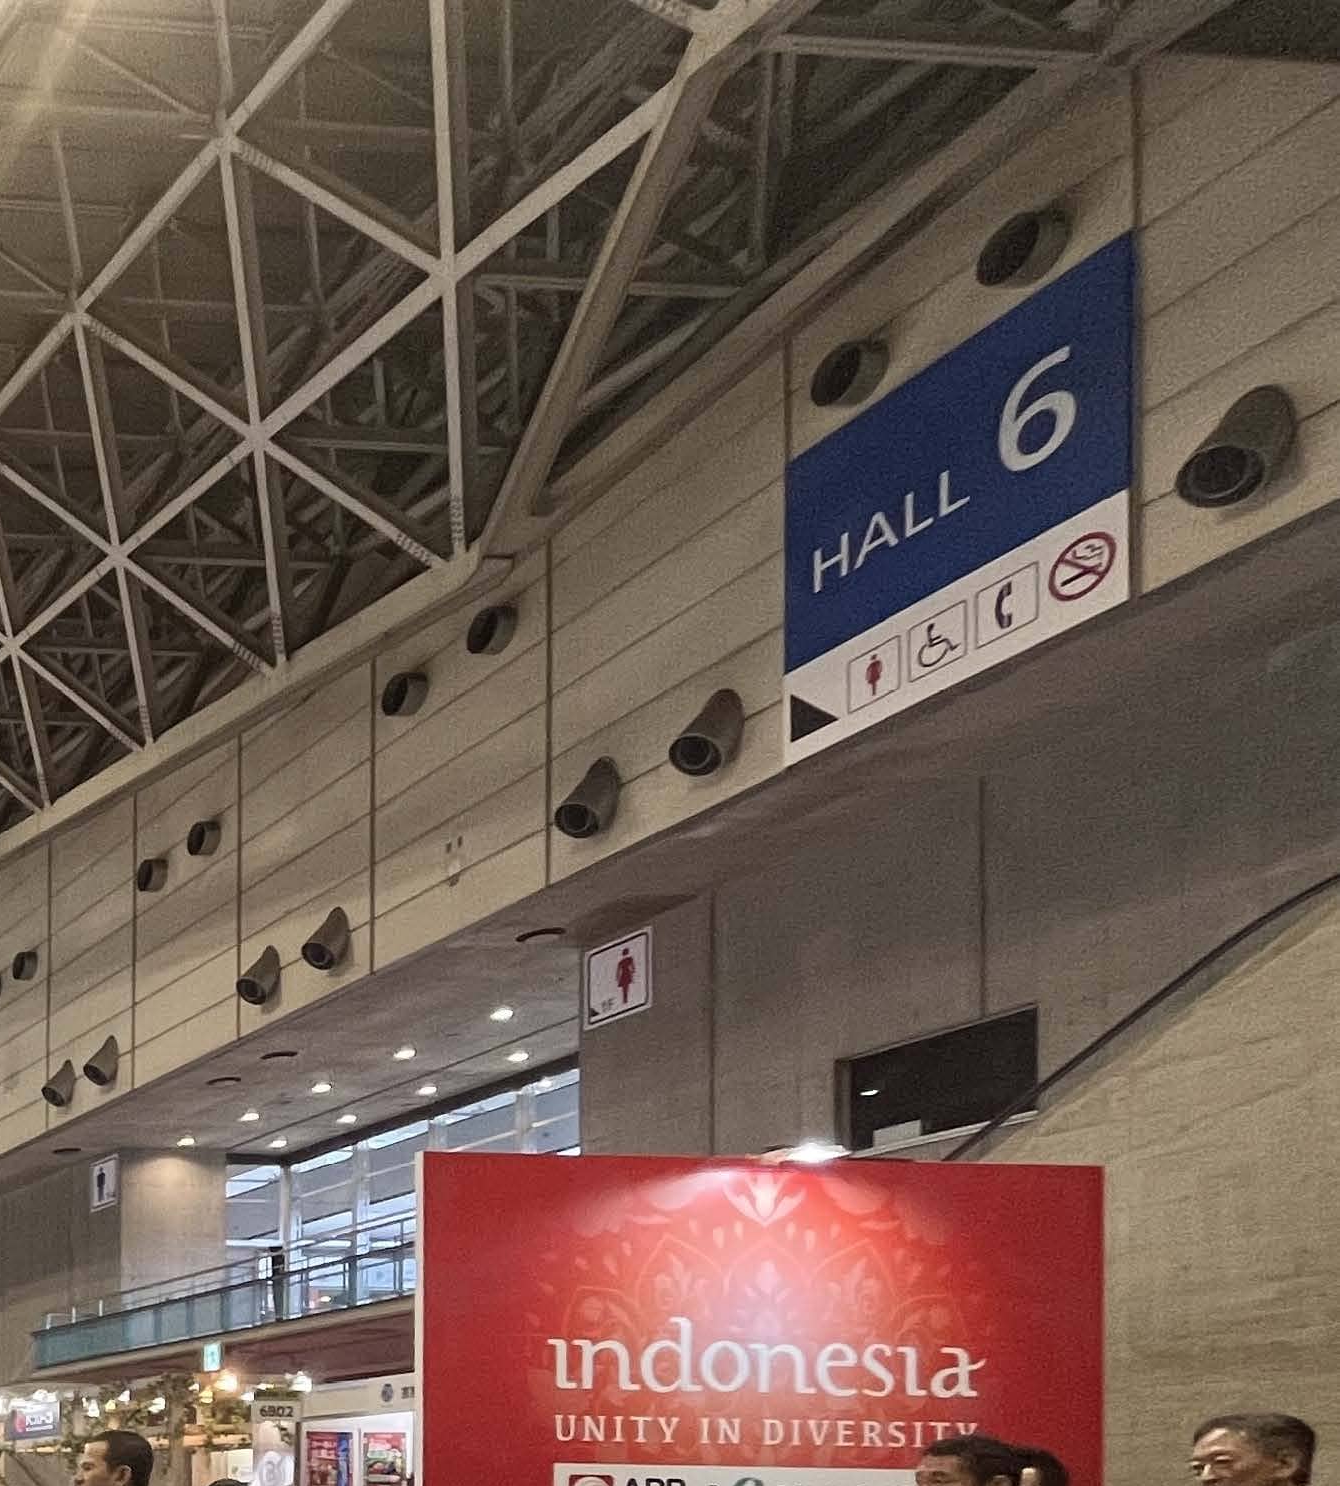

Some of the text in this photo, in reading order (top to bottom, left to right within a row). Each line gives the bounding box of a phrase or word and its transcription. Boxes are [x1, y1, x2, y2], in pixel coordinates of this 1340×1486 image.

[813, 345, 1077, 594] HALL 6
[547, 1317, 987, 1398] indonesia
[554, 1414, 979, 1449] UNITY IN DIVERSITY
